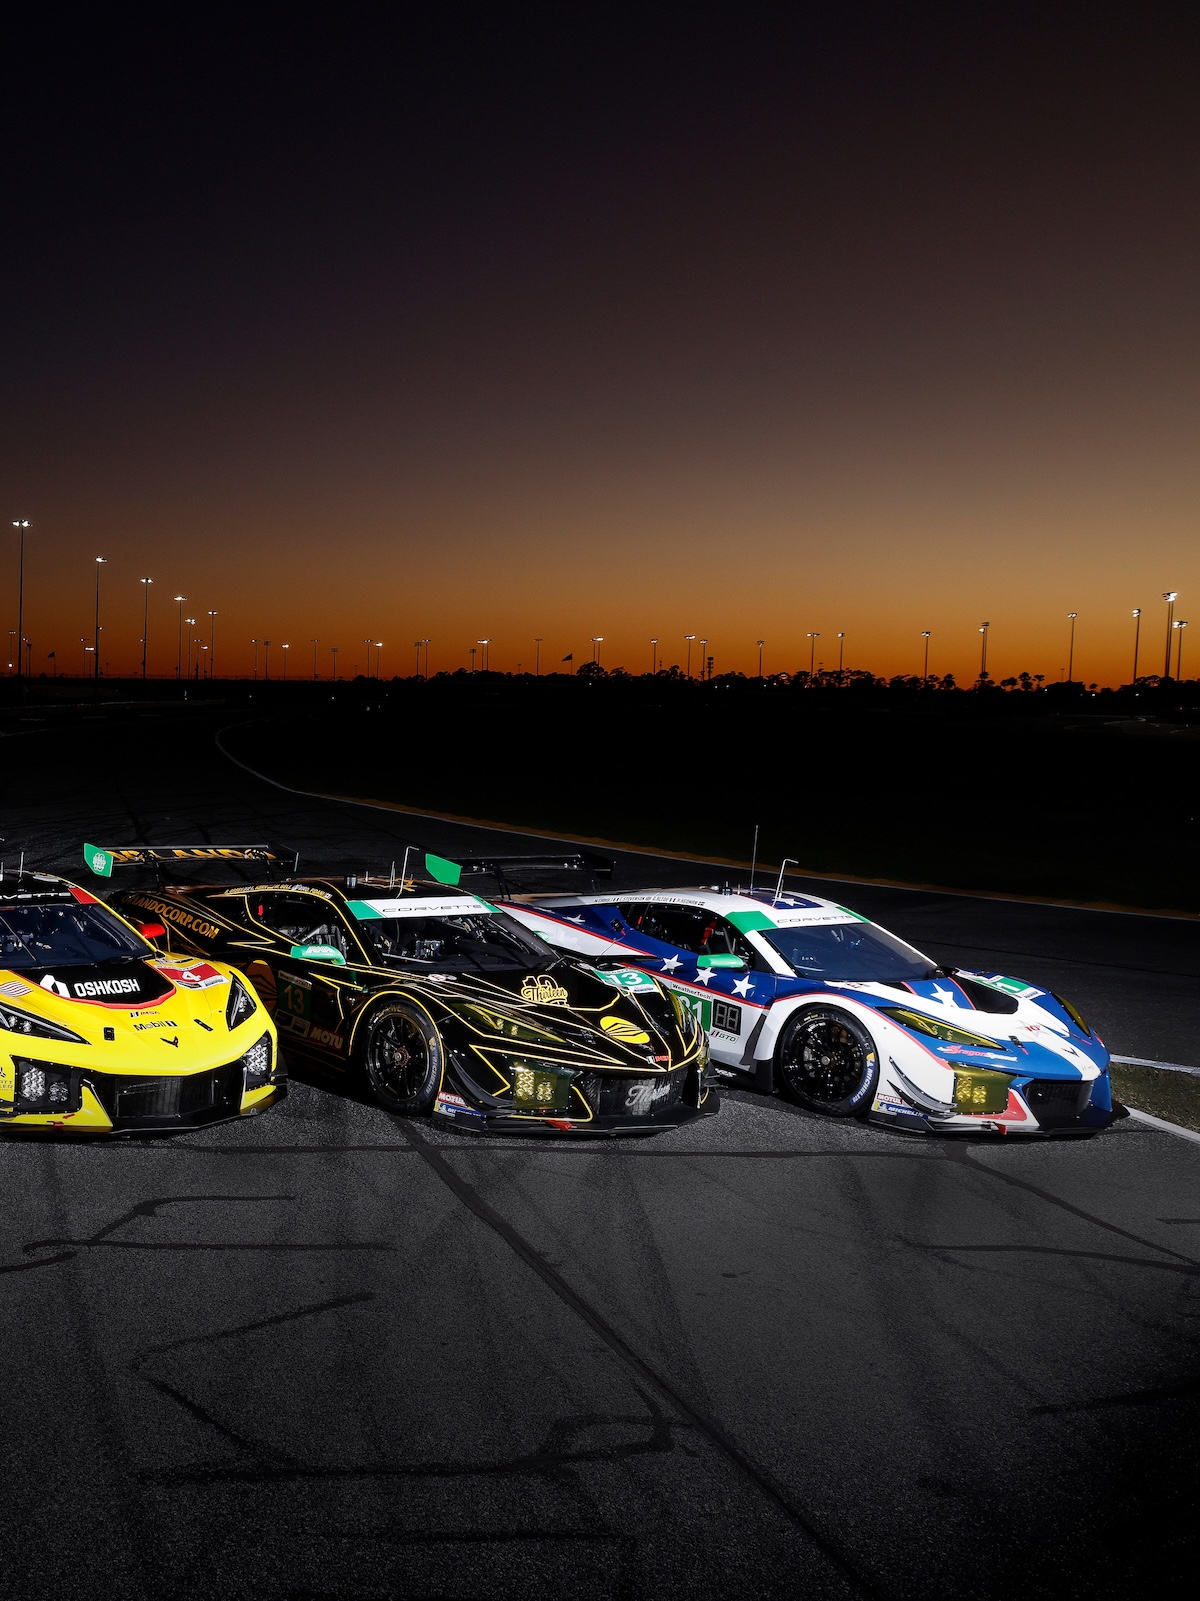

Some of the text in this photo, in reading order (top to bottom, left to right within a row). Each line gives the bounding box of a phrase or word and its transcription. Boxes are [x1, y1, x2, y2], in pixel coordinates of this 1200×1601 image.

[382, 904, 482, 913] CORVETTE
[776, 915, 853, 924] CORVETTE
[181, 970, 202, 982] 4
[605, 972, 643, 986] 13
[73, 978, 141, 998] OSHKOSH
[672, 982, 712, 1000] WeatherTech
[284, 985, 305, 1015] 13
[133, 1020, 167, 1031] Mobil
[719, 1032, 737, 1042] GTD
[852, 1068, 874, 1103] MICHELIN
[877, 1093, 902, 1104] MOTUL
[887, 1106, 925, 1118] MICHELIN
